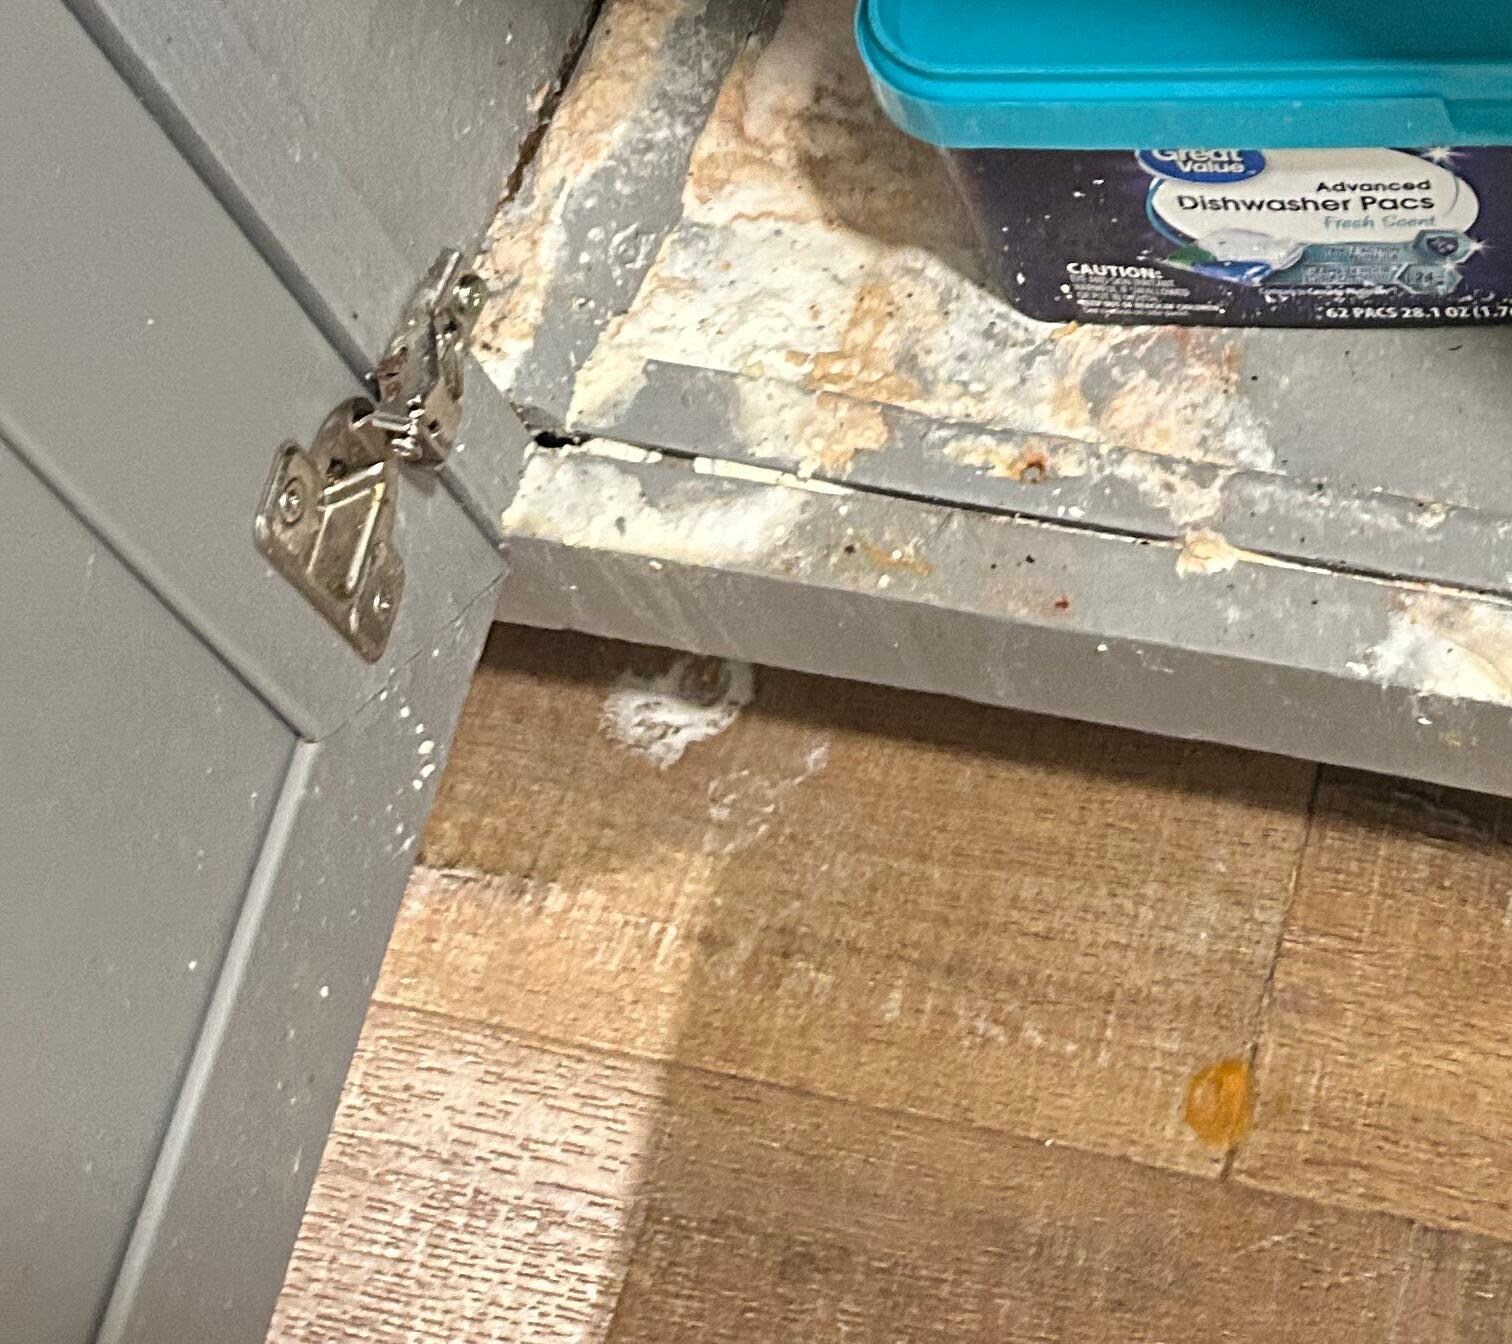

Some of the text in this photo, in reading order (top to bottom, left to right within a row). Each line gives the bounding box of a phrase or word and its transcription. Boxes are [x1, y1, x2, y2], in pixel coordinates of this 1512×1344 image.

[1177, 161, 1246, 174] Value
[1316, 179, 1432, 193] Advanced
[1176, 194, 1435, 213] Dishwasher Pacs
[1322, 214, 1435, 230] Fresh Scent
[1066, 262, 1164, 280] CAUTION:
[1325, 307, 1350, 319] 62
[1351, 307, 1399, 319] PACS
[1400, 306, 1441, 319] 28.1
[1444, 306, 1472, 319] OZ
